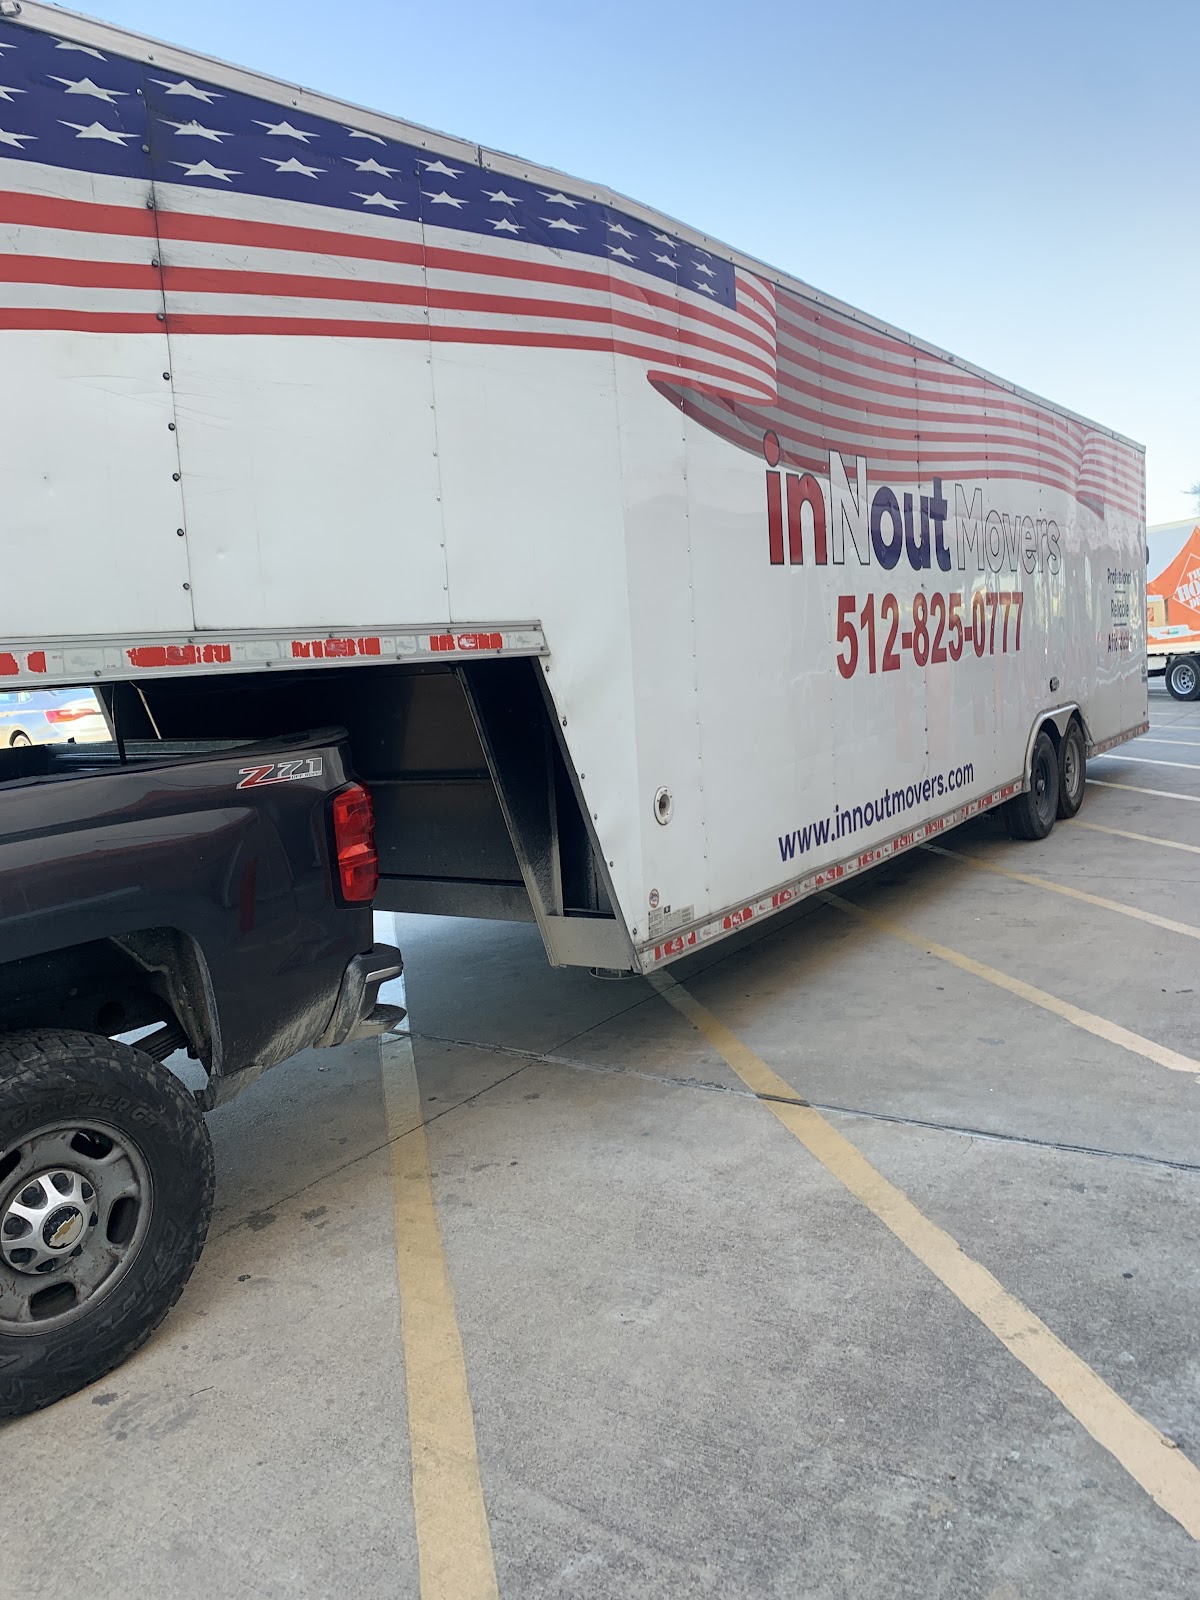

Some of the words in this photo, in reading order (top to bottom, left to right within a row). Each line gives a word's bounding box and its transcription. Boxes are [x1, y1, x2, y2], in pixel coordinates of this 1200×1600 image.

[763, 429, 951, 572] inNout
[954, 483, 1062, 575] Movers
[836, 591, 1024, 679] 512-825-0777
[1110, 599, 1130, 618] Reliable
[1107, 631, 1132, 653] Affodab
[236, 757, 322, 789] Z71
[778, 762, 974, 862] www.innoutmovers.com
